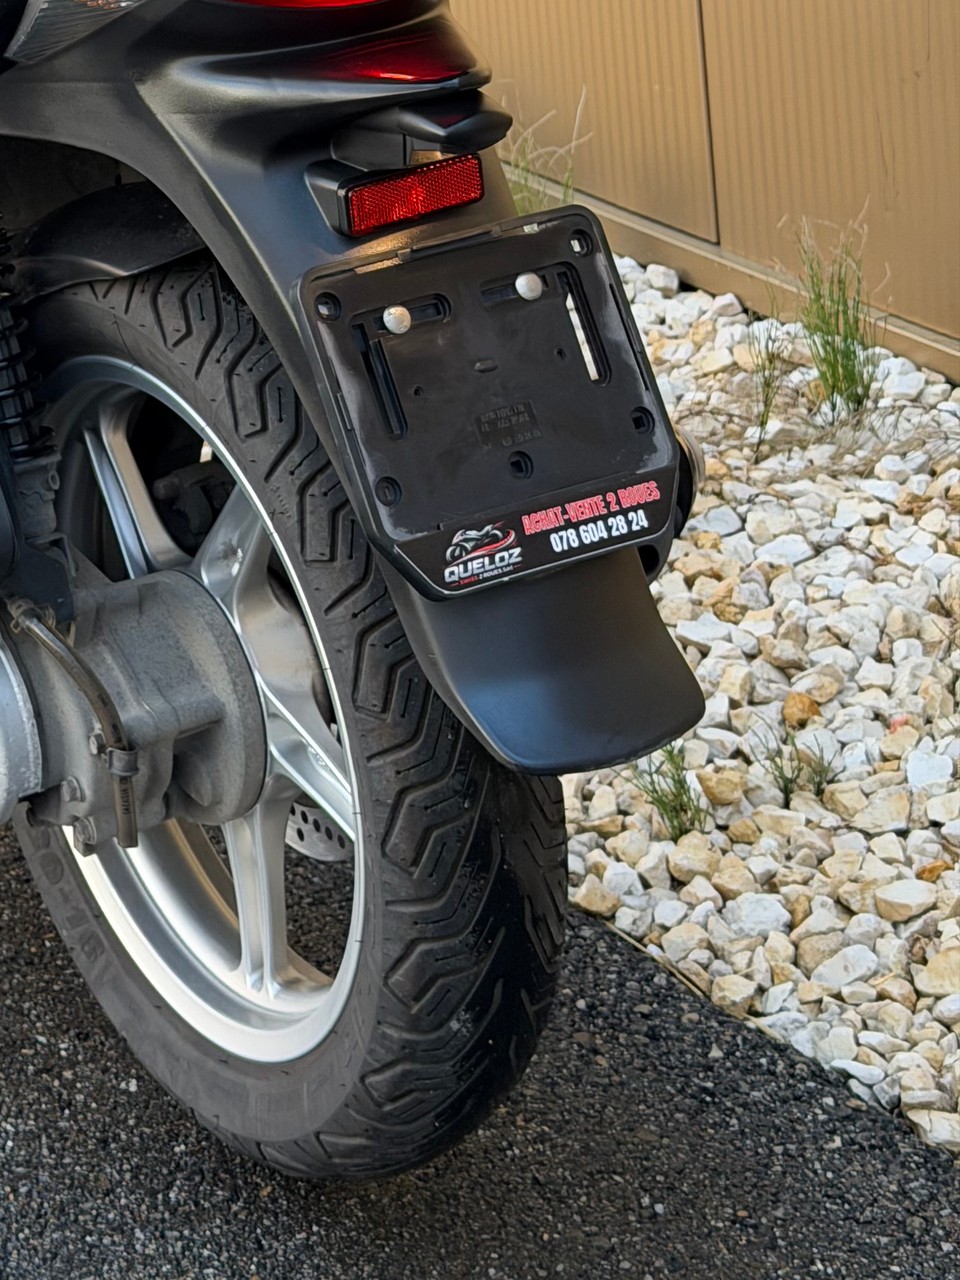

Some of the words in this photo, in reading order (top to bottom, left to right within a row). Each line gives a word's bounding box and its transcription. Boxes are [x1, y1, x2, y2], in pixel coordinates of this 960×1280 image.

[605, 492, 620, 512] 2
[617, 480, 661, 509] ROUES
[549, 528, 579, 553] 078
[578, 520, 609, 545] 604
[607, 514, 628, 537] 28
[627, 508, 649, 531] 24
[444, 546, 523, 583] QUELOZ
